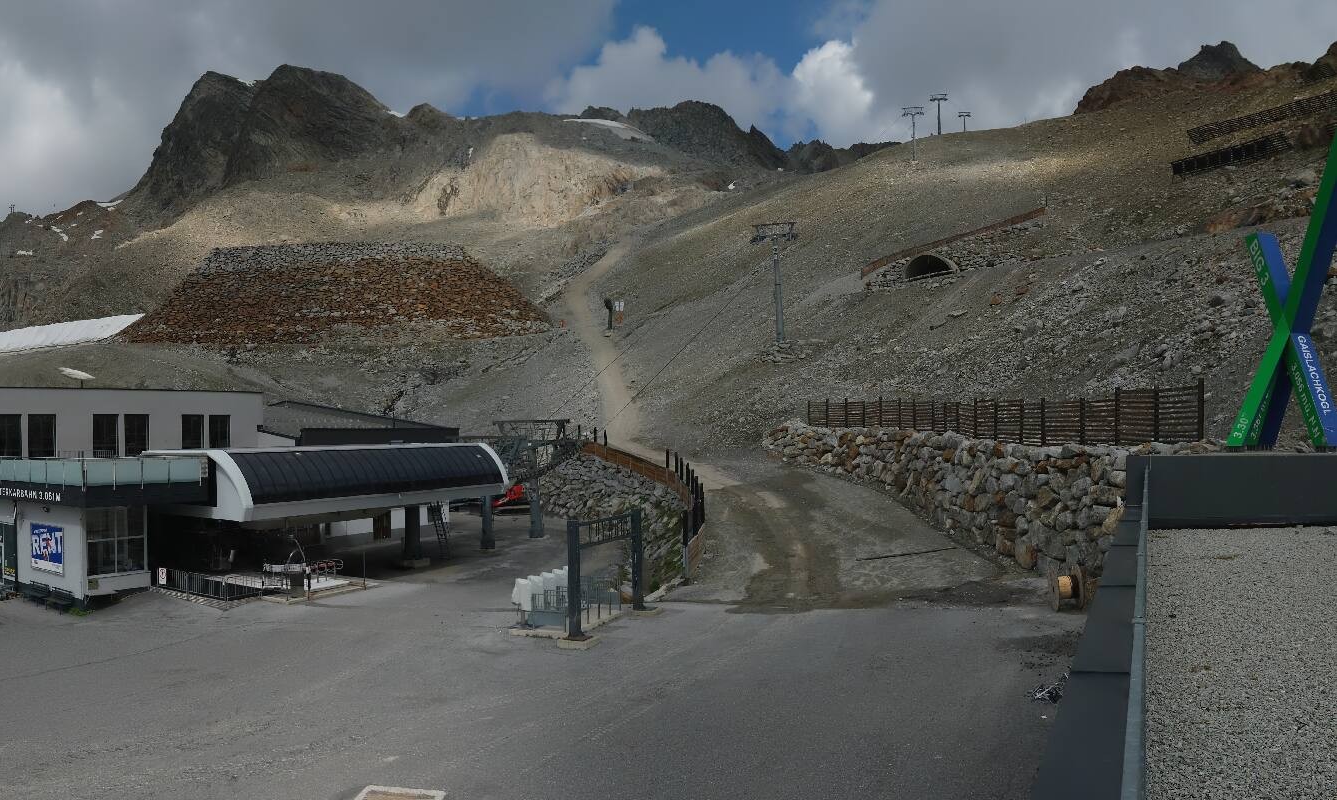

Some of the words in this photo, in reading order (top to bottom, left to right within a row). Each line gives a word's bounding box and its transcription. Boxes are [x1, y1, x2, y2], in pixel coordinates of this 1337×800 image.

[1249, 238, 1265, 269] BIG
[1260, 272, 1269, 286] 3
[31, 531, 63, 555] RENT
